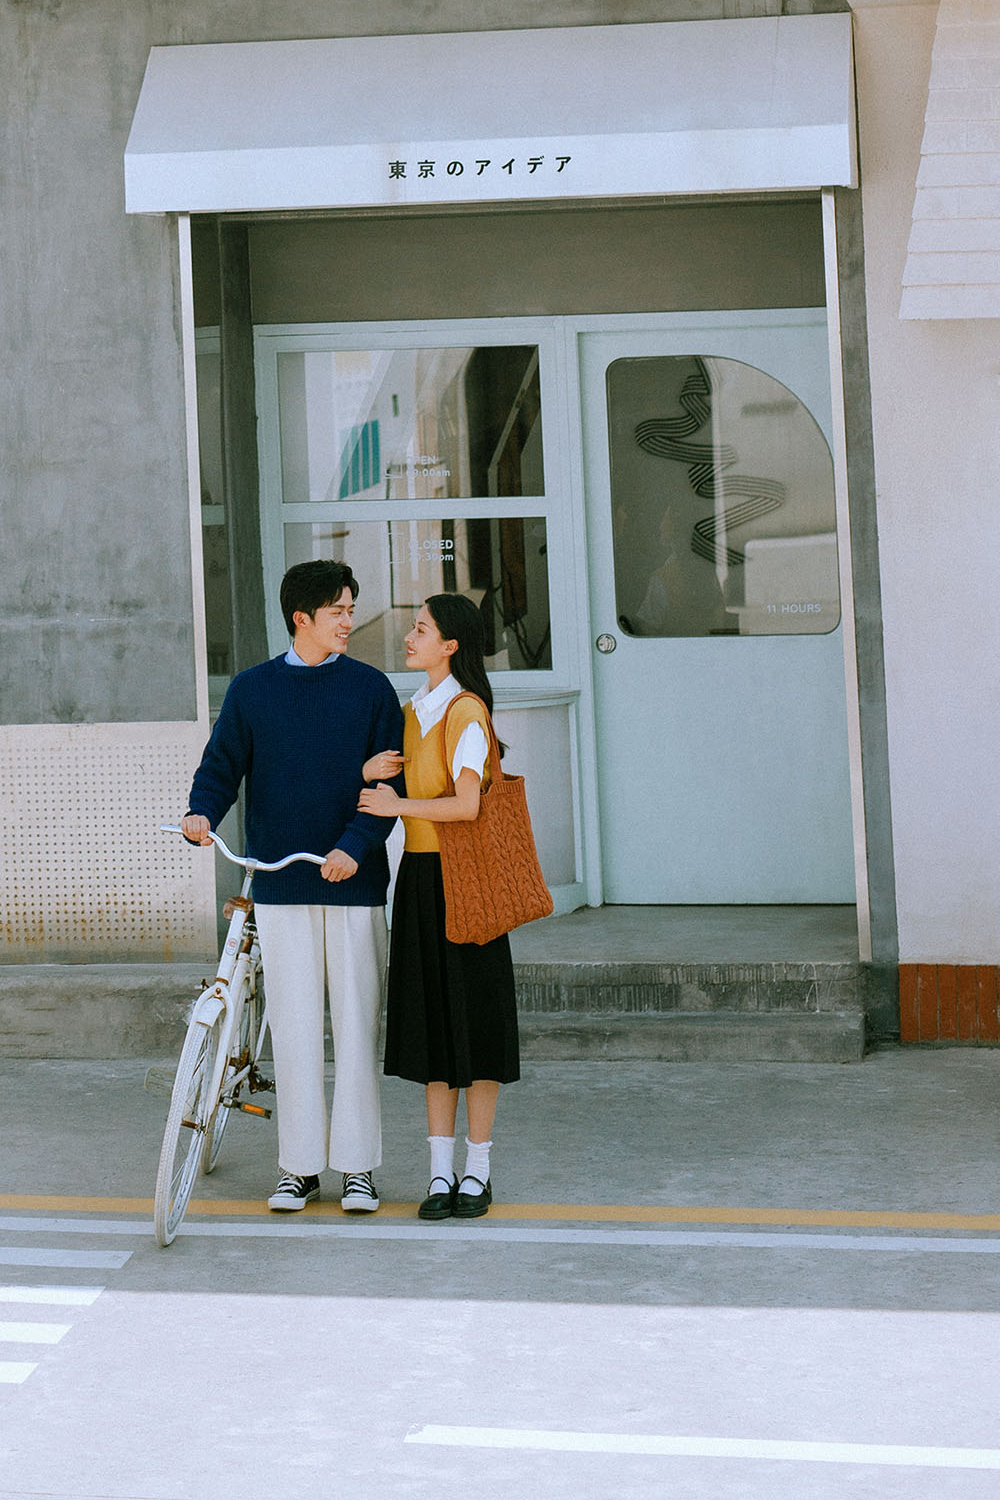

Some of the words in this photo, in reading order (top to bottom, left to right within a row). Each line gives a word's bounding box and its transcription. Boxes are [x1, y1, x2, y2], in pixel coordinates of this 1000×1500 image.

[388, 156, 572, 180] 東京のアイデア
[781, 603, 821, 613] HOURS
